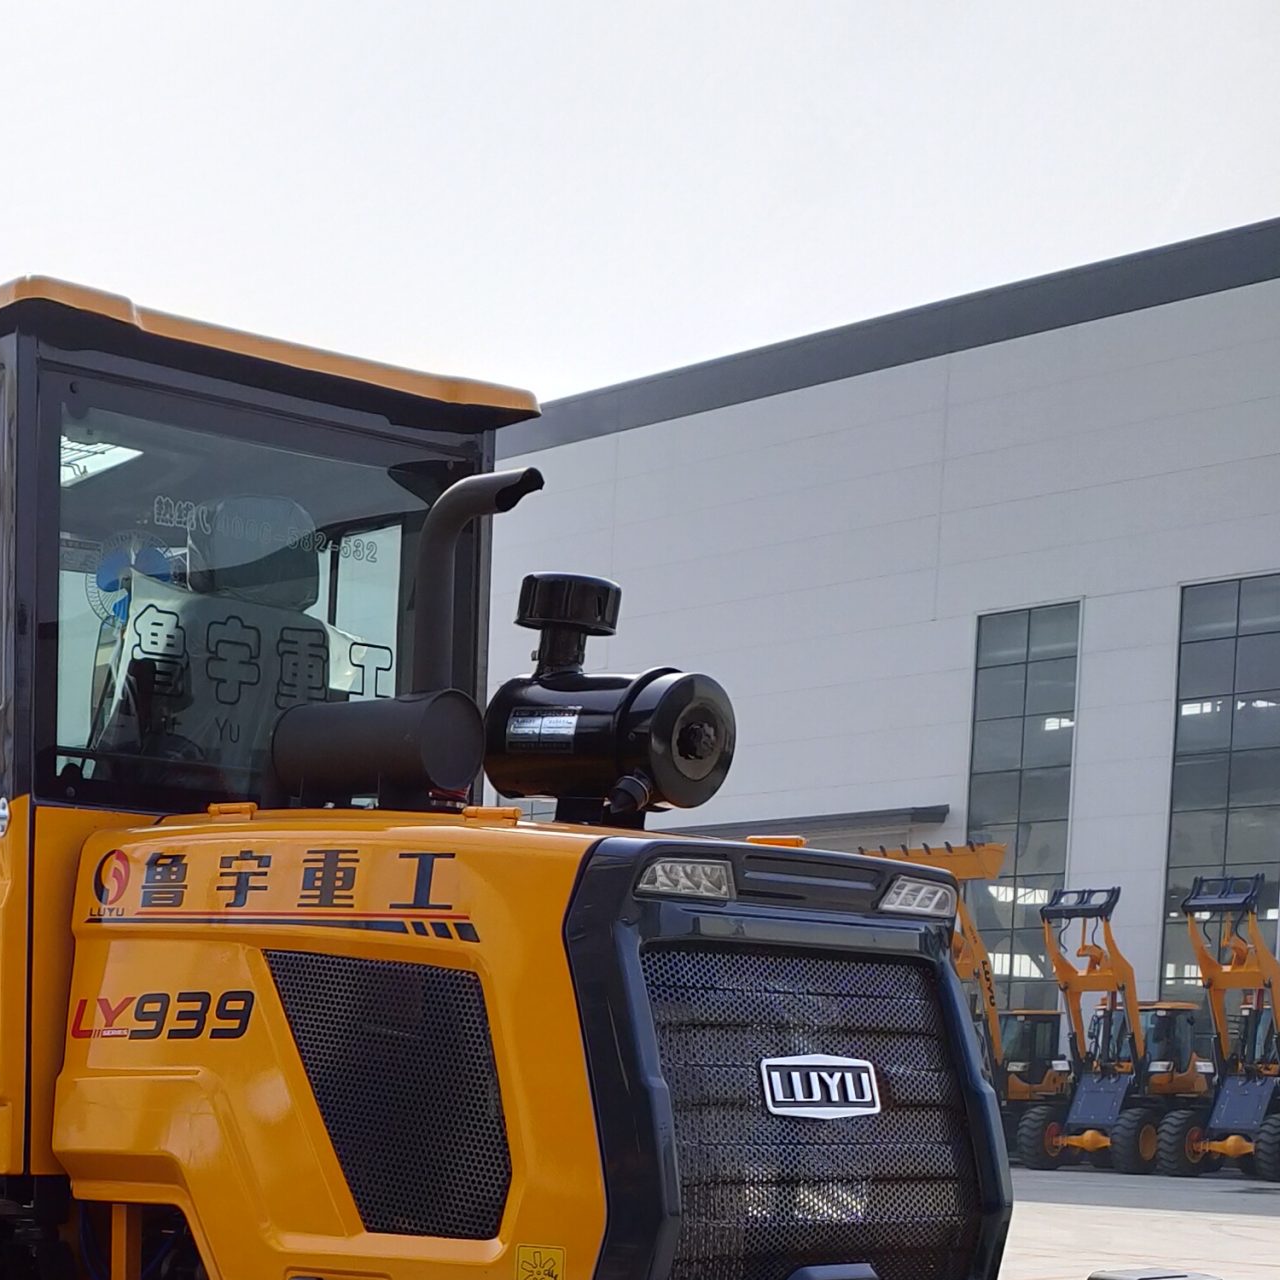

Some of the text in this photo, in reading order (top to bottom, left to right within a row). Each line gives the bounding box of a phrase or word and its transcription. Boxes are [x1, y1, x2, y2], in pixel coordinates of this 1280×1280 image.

[140, 849, 456, 911] 鲁宇重工
[89, 907, 125, 917] LUYU
[71, 990, 255, 1040] LY939
[770, 1070, 872, 1102] LUYU
